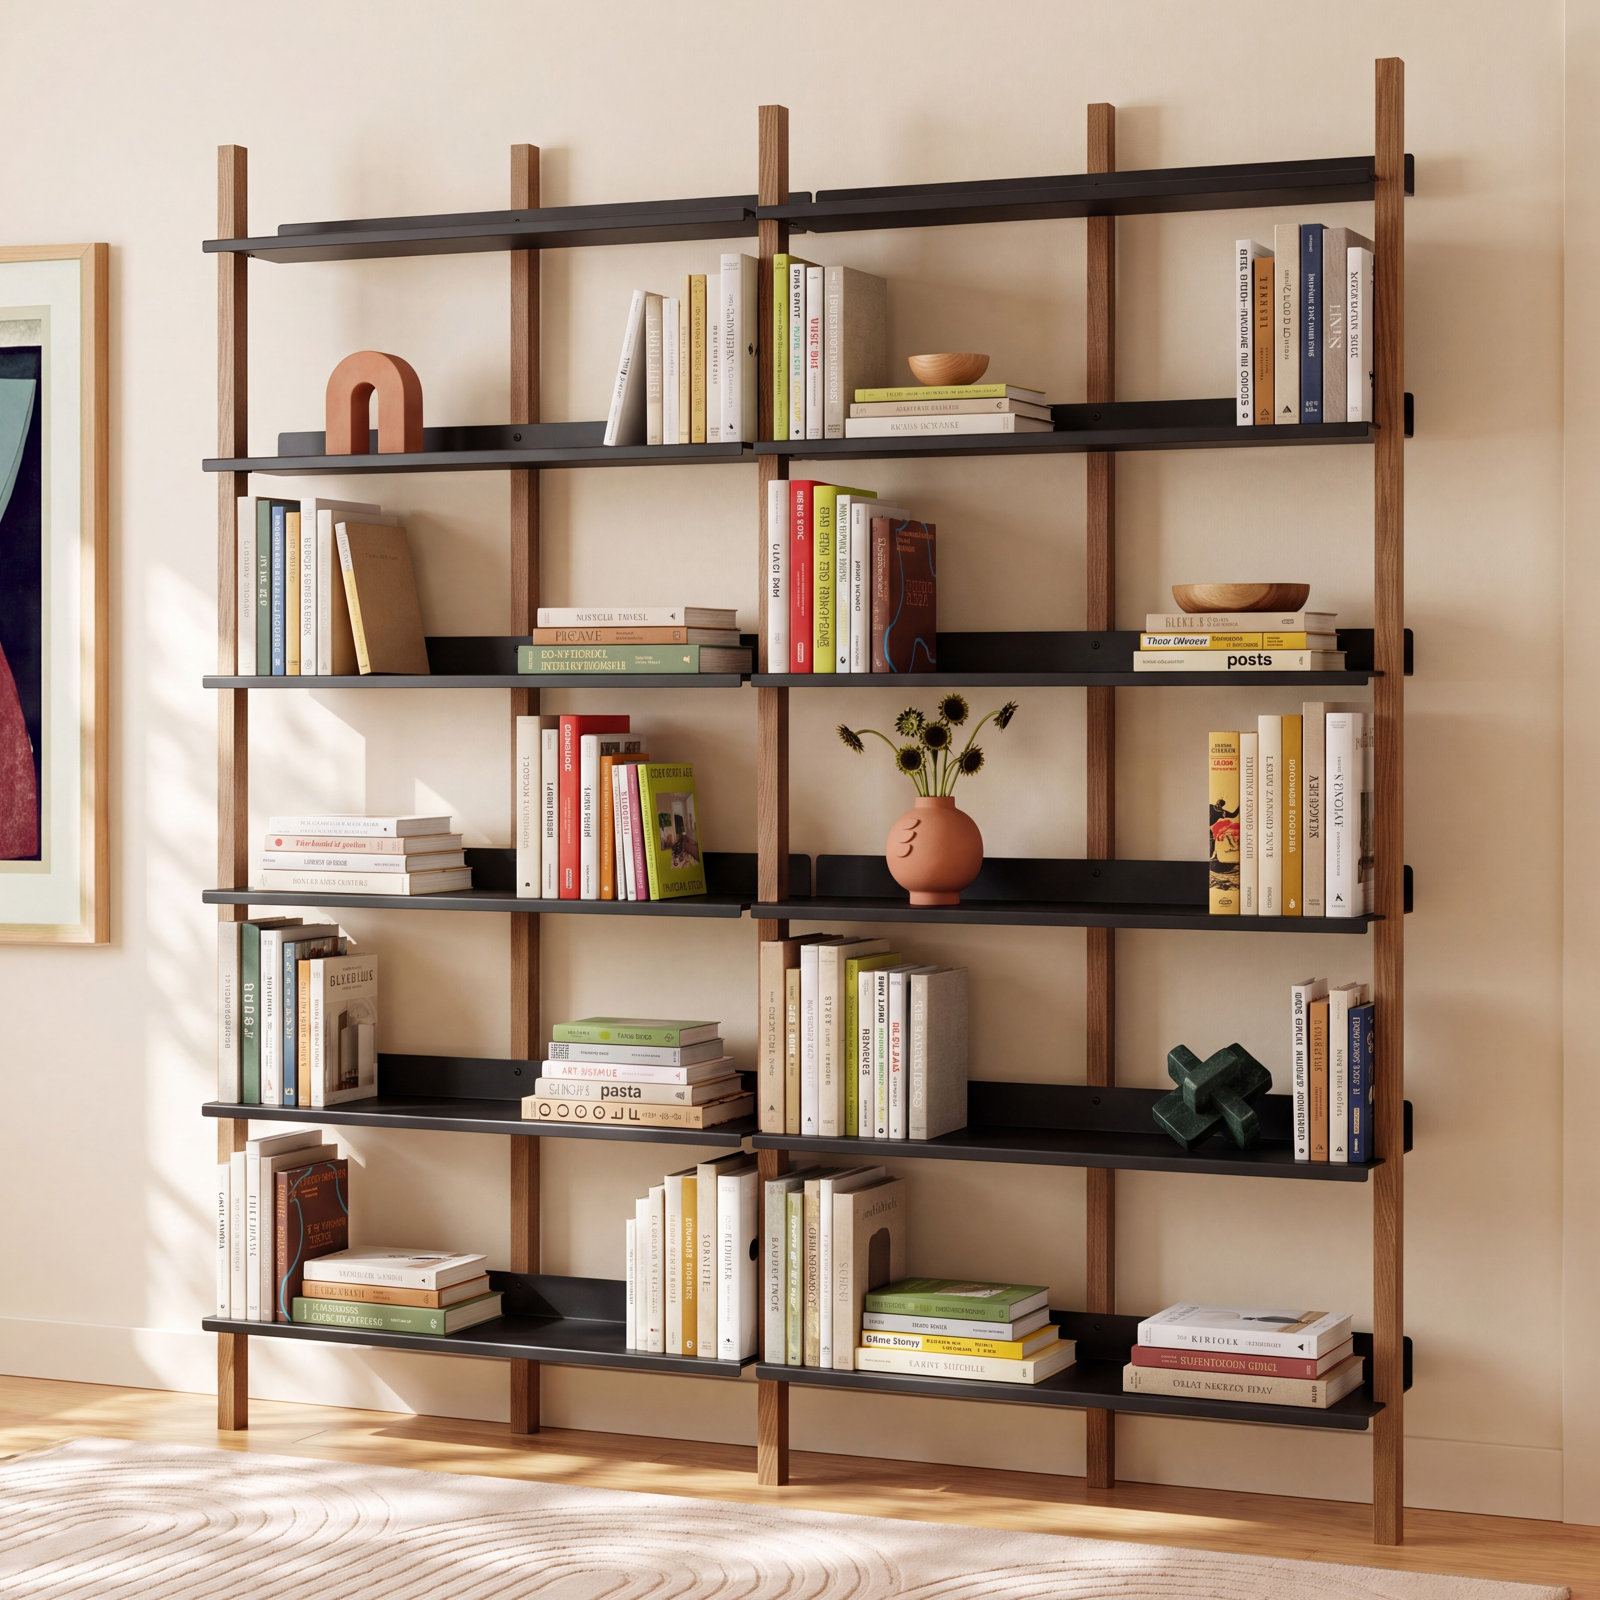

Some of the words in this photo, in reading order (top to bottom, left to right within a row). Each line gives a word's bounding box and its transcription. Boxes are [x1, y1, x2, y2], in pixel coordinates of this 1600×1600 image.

[1227, 653, 1273, 669] posts
[562, 1066, 578, 1076] ART
[601, 1085, 642, 1100] pasta
